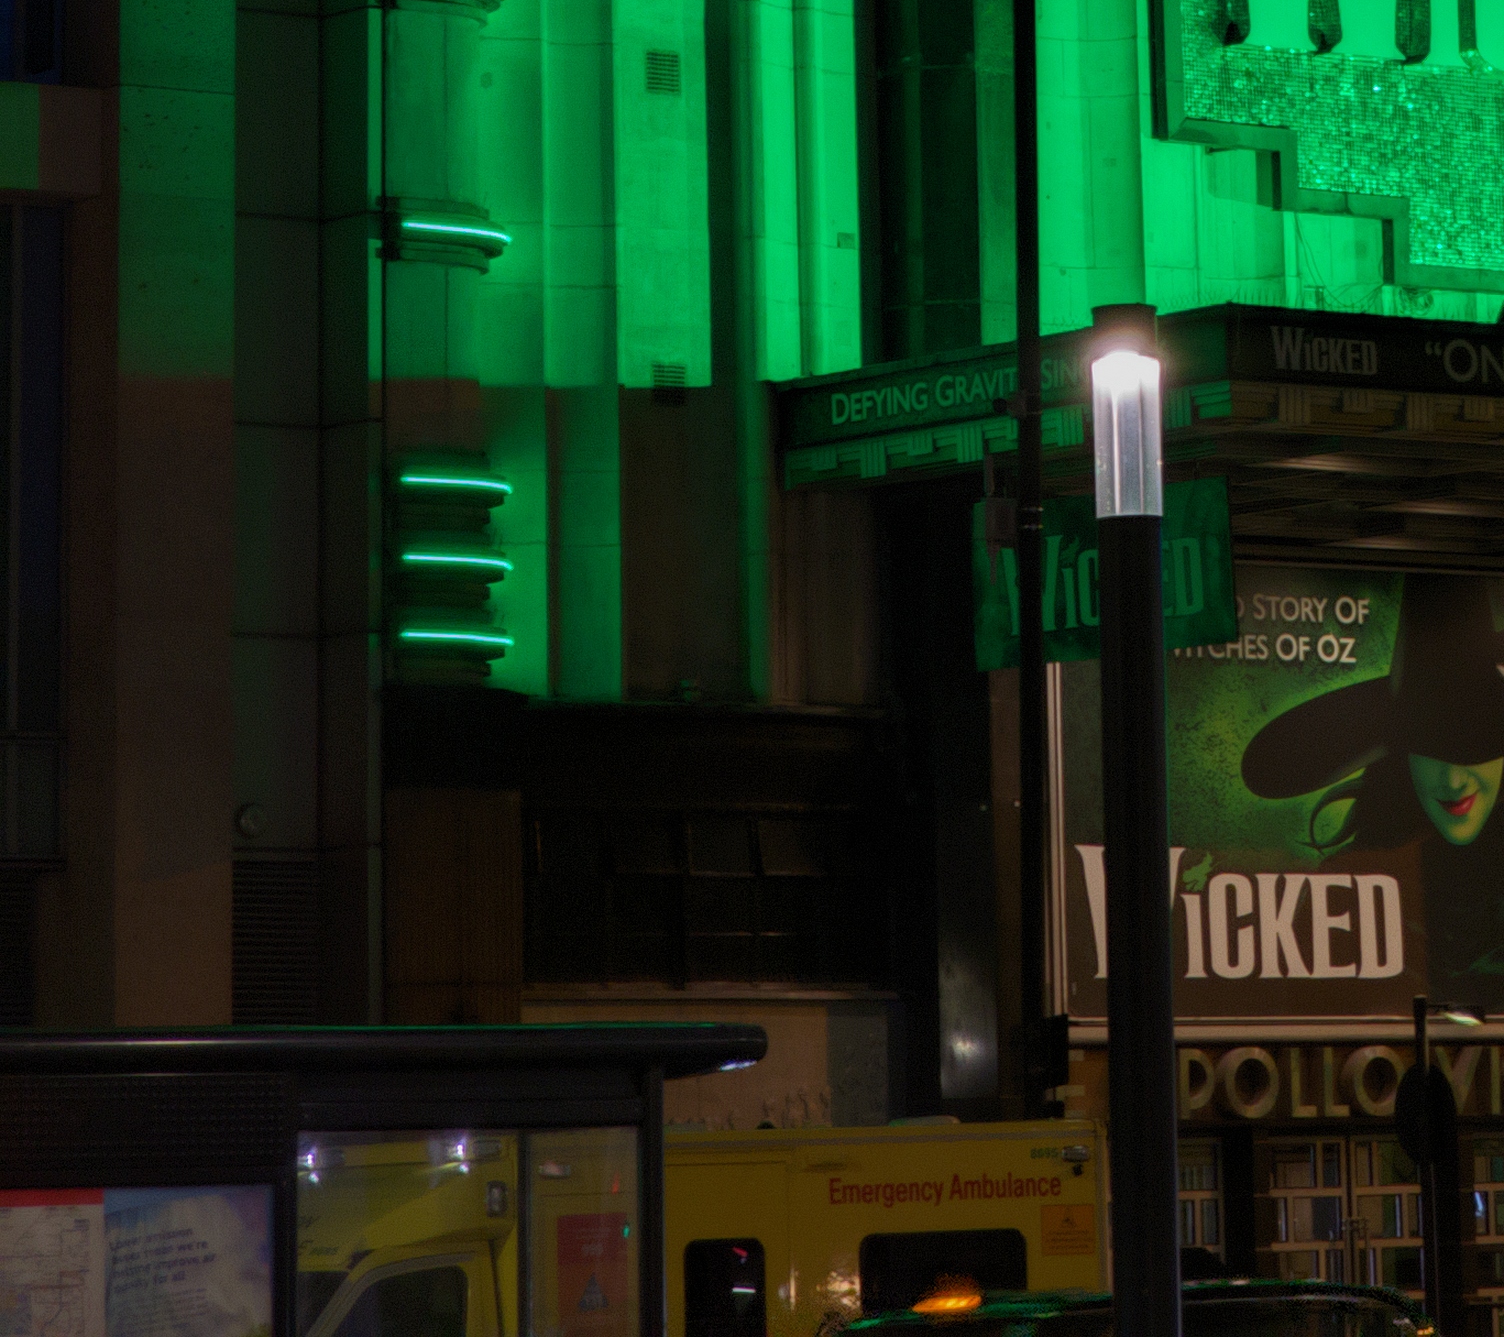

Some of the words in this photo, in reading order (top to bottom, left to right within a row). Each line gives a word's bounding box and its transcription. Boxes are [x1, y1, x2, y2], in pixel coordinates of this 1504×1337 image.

[830, 381, 928, 425] DEFYING
[935, 367, 1018, 408] GRAVIT
[1252, 593, 1328, 623] STORY
[1334, 596, 1370, 625] OF
[1275, 633, 1311, 662] OF
[1316, 631, 1357, 664] OZ
[1178, 1044, 1406, 1119] POLLO
[829, 1178, 945, 1208] Emergency
[949, 1173, 1061, 1201] Ambulance
